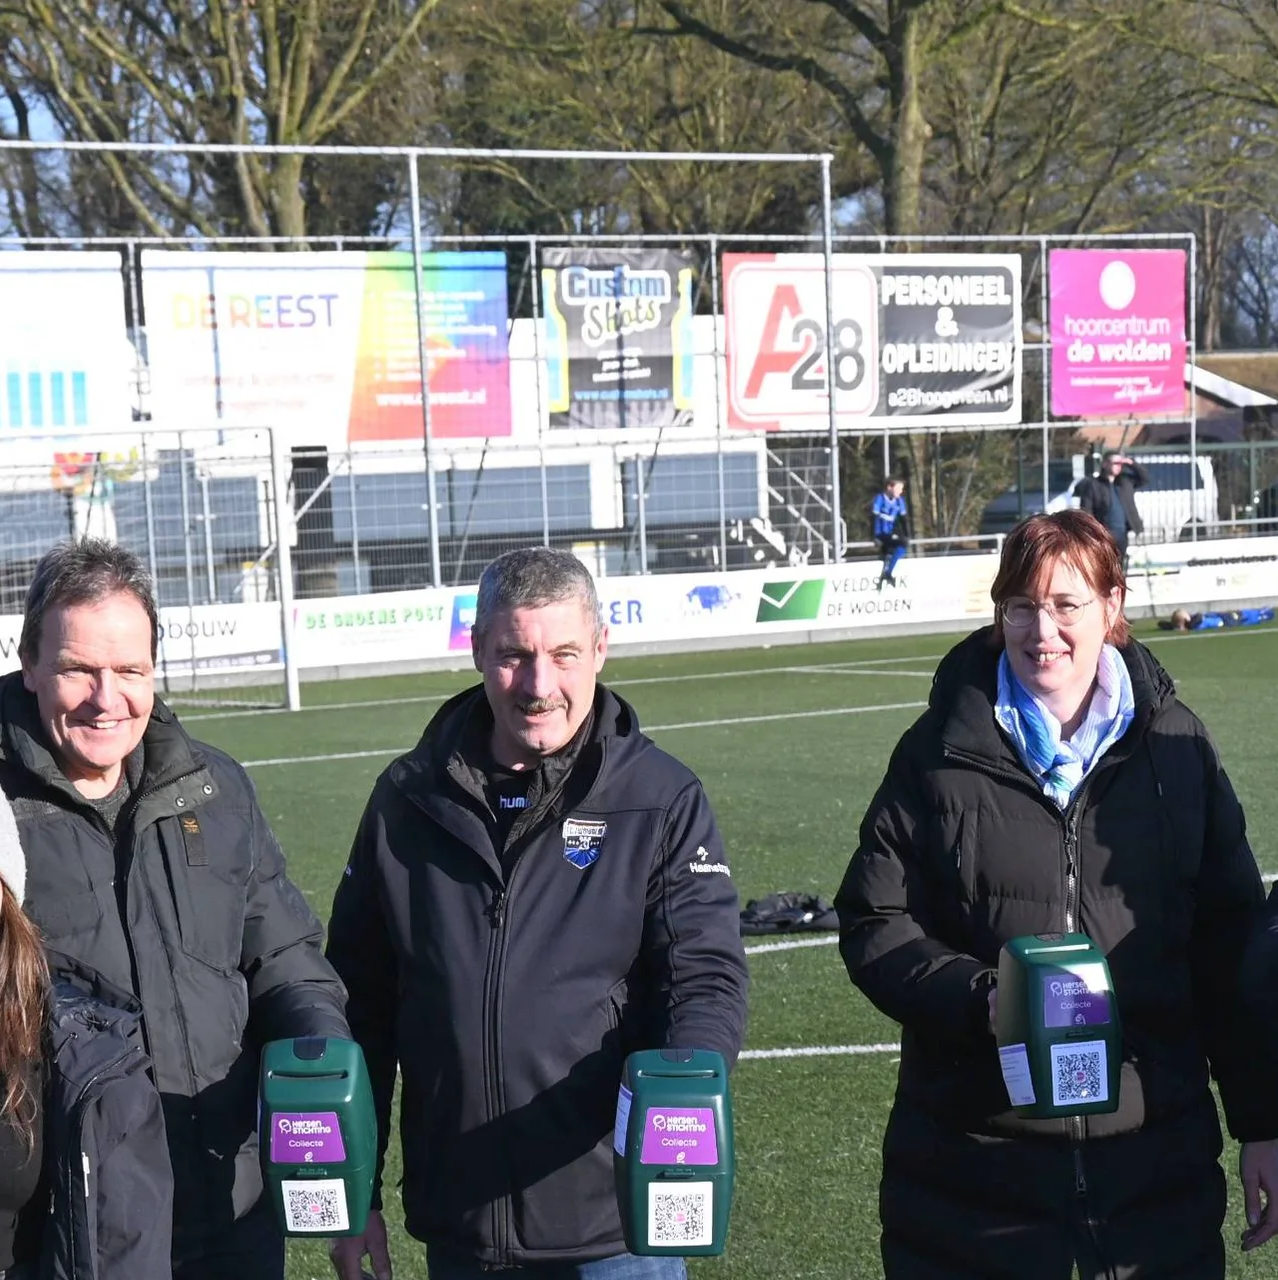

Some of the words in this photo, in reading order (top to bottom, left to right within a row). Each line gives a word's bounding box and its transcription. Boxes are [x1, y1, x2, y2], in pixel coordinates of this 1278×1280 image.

[568, 267, 666, 298] Custom
[881, 275, 1011, 305] PERSONEEL
[229, 293, 339, 329] REEST
[587, 297, 656, 340] Shots
[934, 307, 960, 337] &
[1064, 314, 1171, 337] hoorcentrum
[744, 284, 866, 398] A28
[1067, 338, 1096, 362] de
[1098, 338, 1172, 362] wolden
[882, 341, 1015, 373] OPLEIDINGEN
[832, 575, 908, 593] VELDSK
[306, 612, 328, 629] DE
[403, 604, 445, 624] POST
[827, 603, 843, 617] DE
[849, 598, 912, 615] WOLDEN
[1061, 1001, 1092, 1010] Collecte
[288, 1139, 324, 1148] Collecte
[661, 1137, 698, 1147] Collecte
